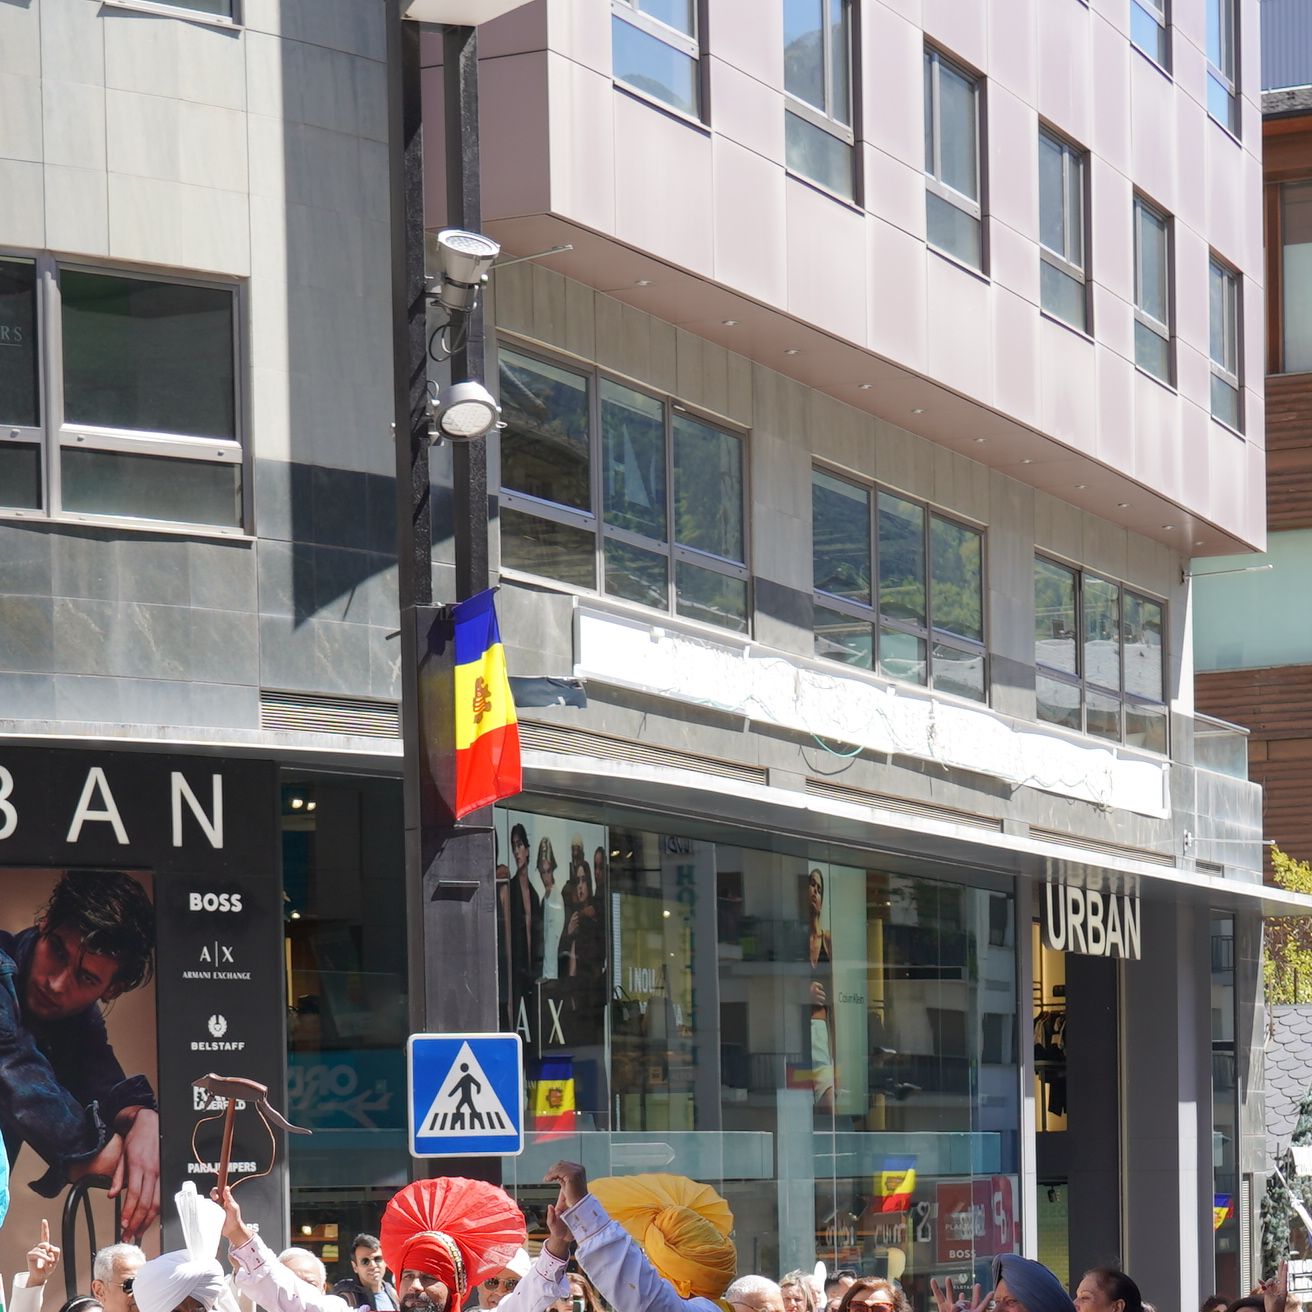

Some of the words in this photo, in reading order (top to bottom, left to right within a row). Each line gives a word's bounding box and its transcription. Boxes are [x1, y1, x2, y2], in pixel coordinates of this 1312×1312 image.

[189, 892, 243, 912] BOSS
[1046, 881, 1141, 960] URBAN
[182, 970, 211, 979] ARMANI
[213, 971, 251, 980] EXCHANGE
[191, 1041, 245, 1051] BELSTAFF
[949, 1249, 976, 1259] BOSS
